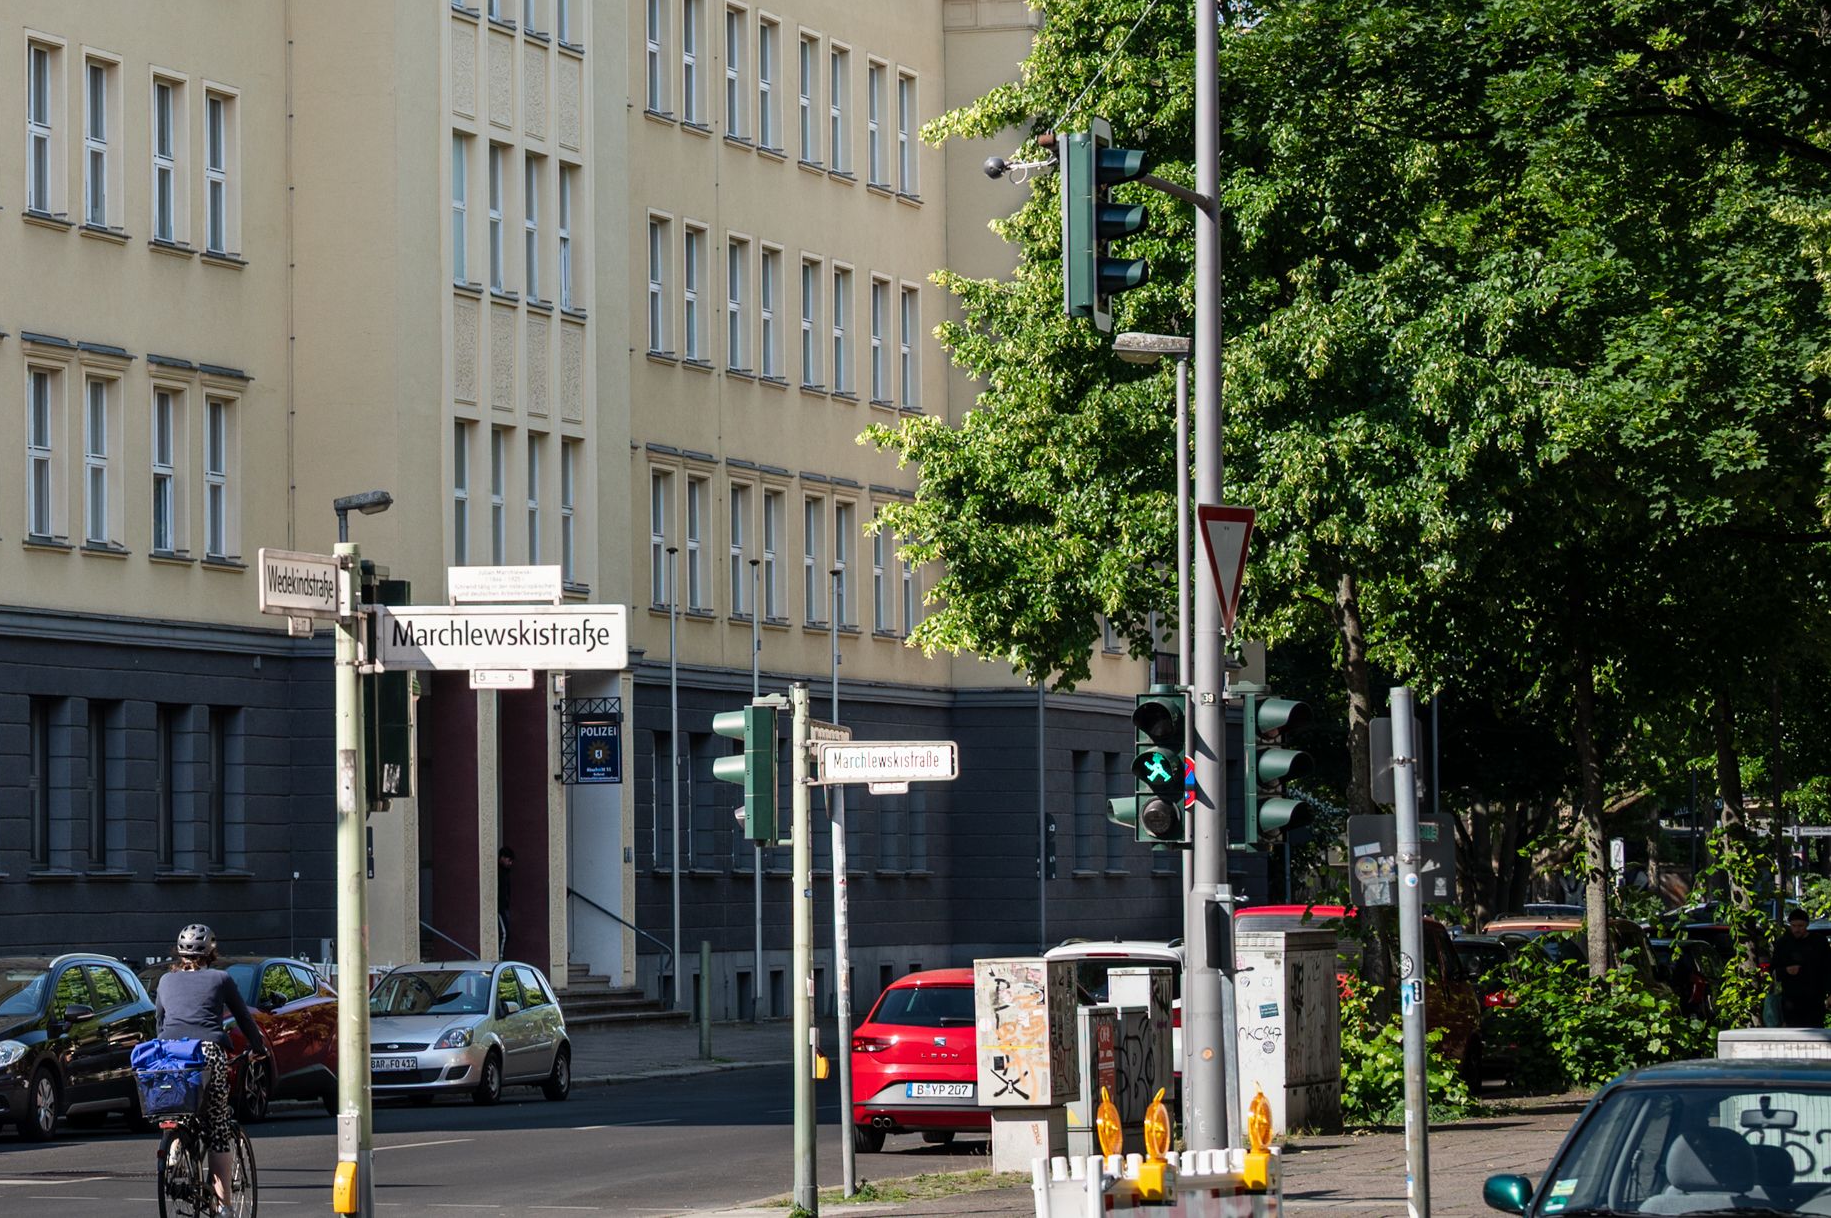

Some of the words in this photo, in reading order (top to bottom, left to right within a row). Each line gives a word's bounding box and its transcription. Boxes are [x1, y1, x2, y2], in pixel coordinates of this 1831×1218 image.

[267, 564, 334, 605] Wedekindstraße
[392, 618, 610, 653] Marchlewskistraße
[1203, 693, 1213, 703] 39
[580, 726, 617, 737] POLIZEI
[833, 750, 939, 769] Marchlewskistraße
[401, 1058, 416, 1068] 412
[917, 1084, 924, 1095] B
[932, 1084, 946, 1095] YP
[947, 1084, 968, 1096] 207
